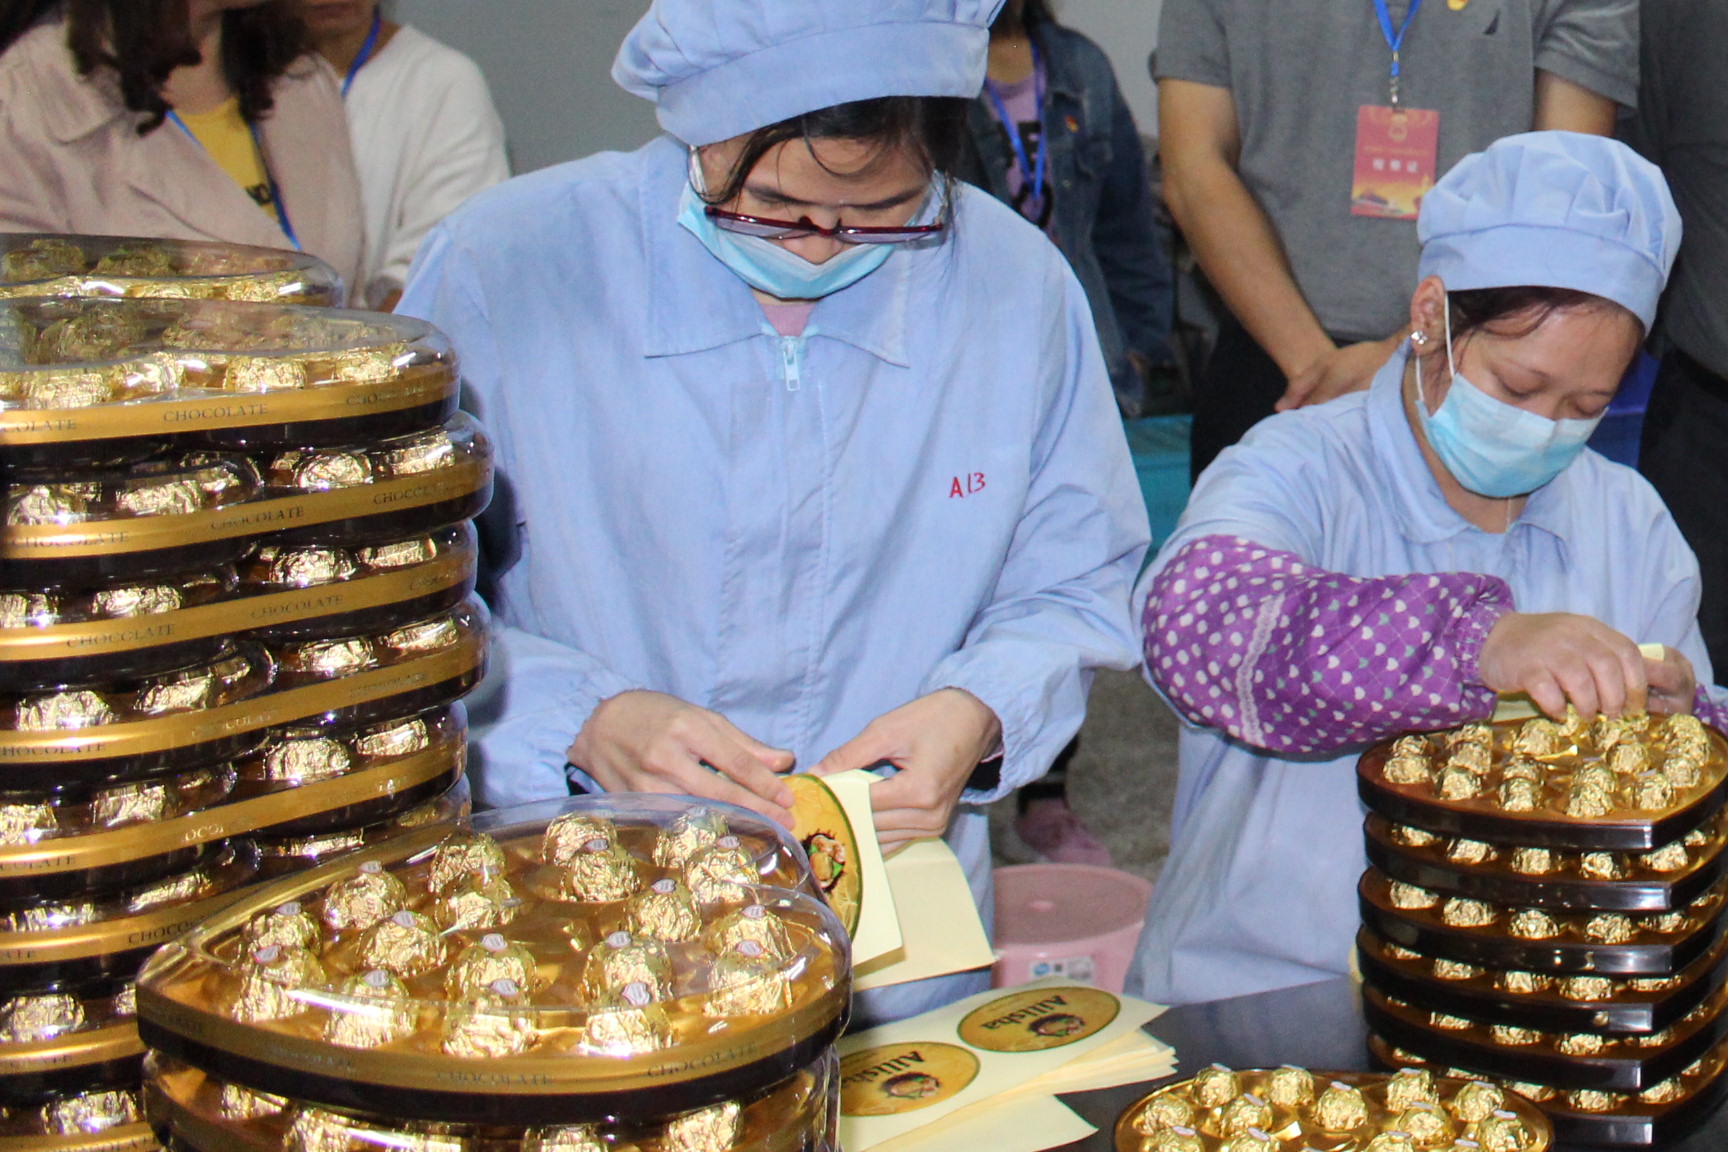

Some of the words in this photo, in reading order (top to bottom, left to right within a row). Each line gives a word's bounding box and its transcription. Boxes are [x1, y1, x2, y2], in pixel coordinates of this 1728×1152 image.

[162, 403, 269, 423] CHOCOLATE
[211, 505, 304, 530] CHOCOLATE
[66, 623, 176, 649] CHOCOLATE
[251, 594, 343, 620] CHOCOLATE
[128, 921, 196, 945] CHOCO
[646, 1046, 757, 1078] CHOCOLATE
